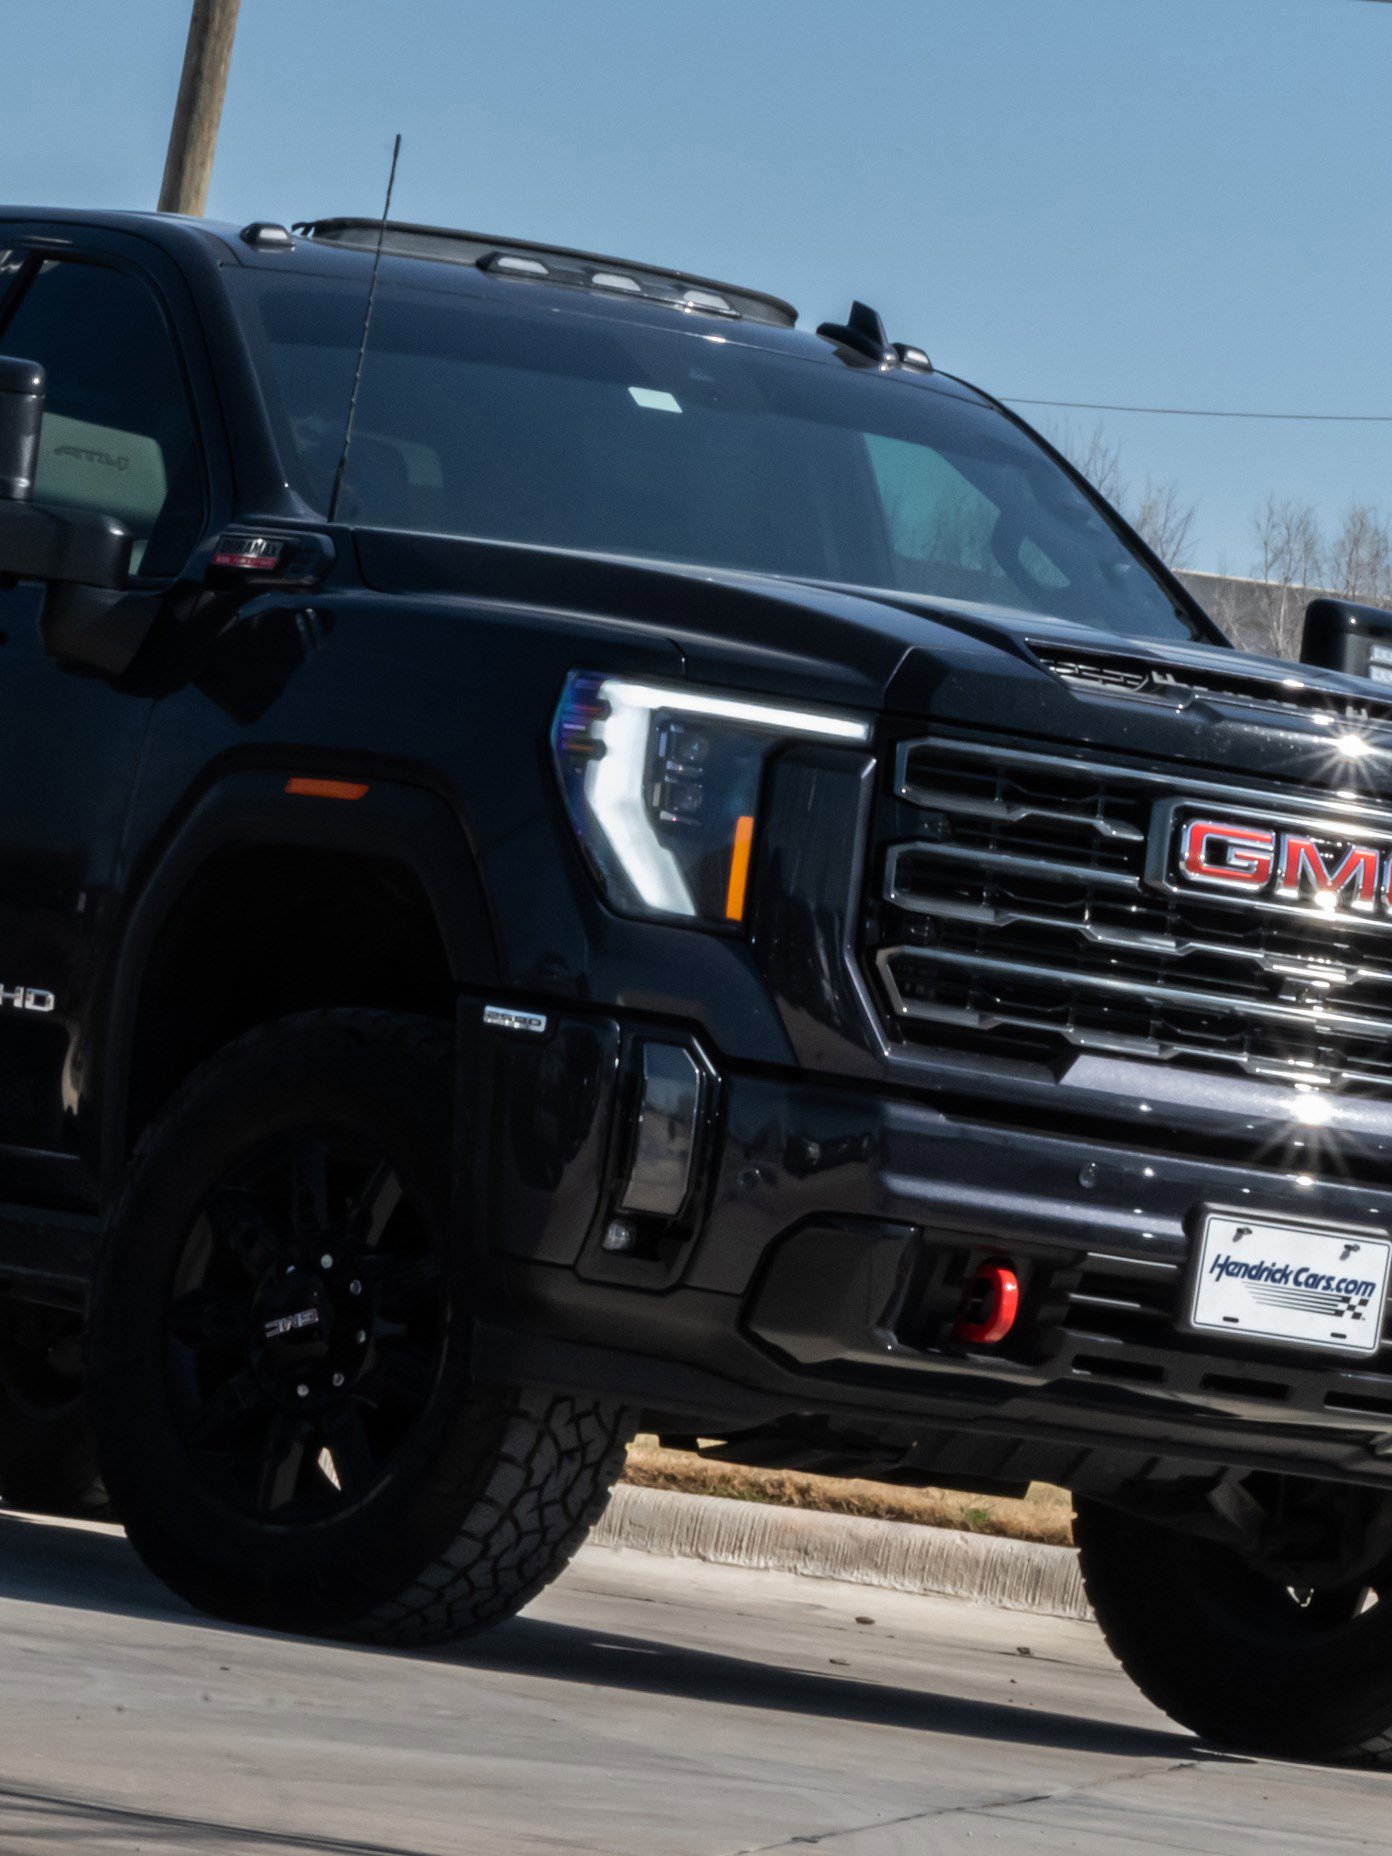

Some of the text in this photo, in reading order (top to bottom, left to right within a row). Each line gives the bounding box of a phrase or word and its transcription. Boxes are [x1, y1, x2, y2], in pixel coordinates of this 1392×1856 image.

[0, 983, 55, 1012] HD
[1209, 1253, 1377, 1298] HendrickCars.com
[264, 1308, 320, 1338] GMC
